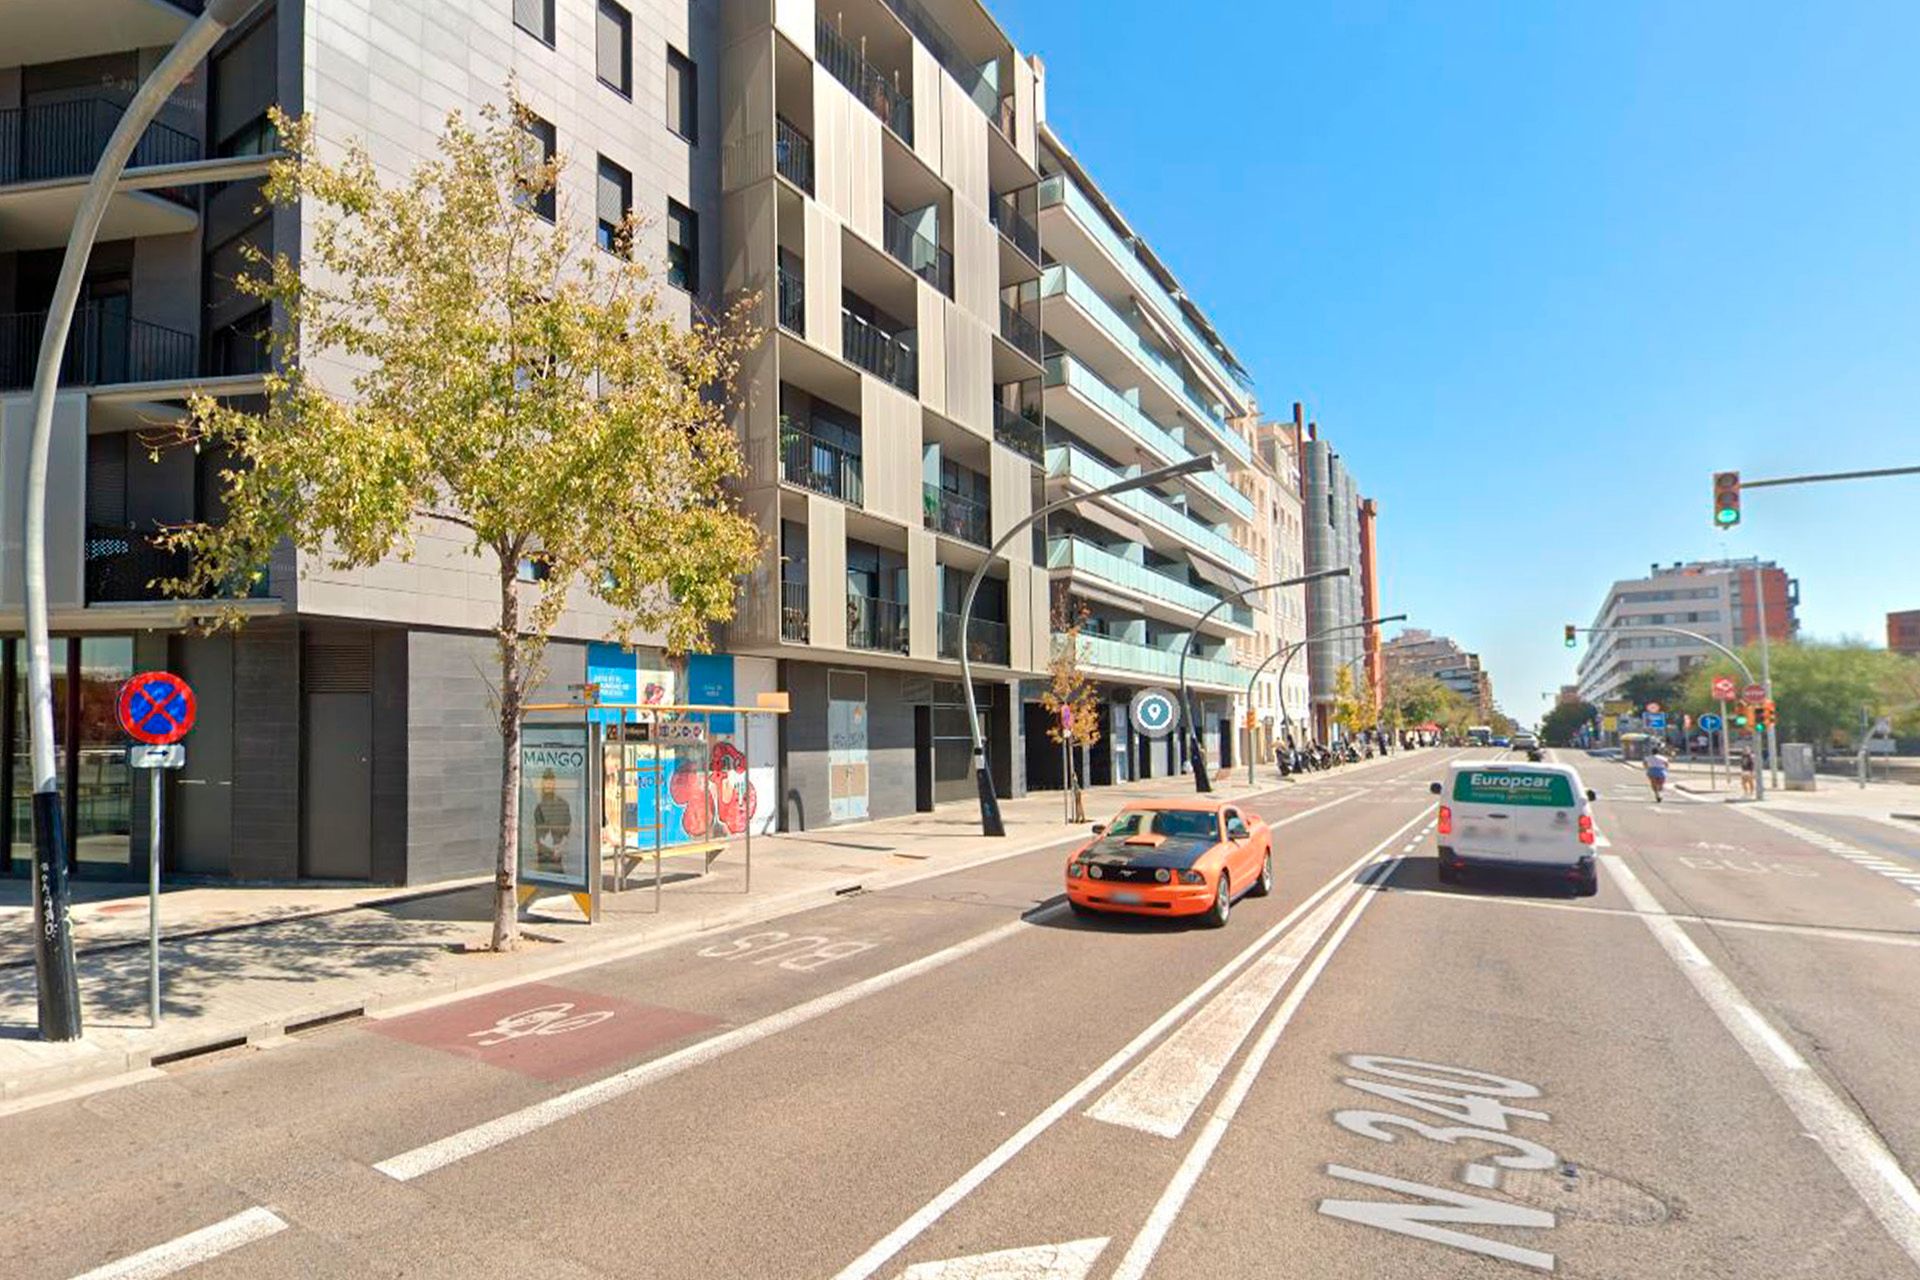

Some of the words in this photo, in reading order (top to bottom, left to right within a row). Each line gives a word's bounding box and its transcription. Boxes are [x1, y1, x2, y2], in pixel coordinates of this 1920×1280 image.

[524, 751, 583, 767] MANGO
[1471, 773, 1554, 789] Europcar
[697, 931, 879, 971] BUS
